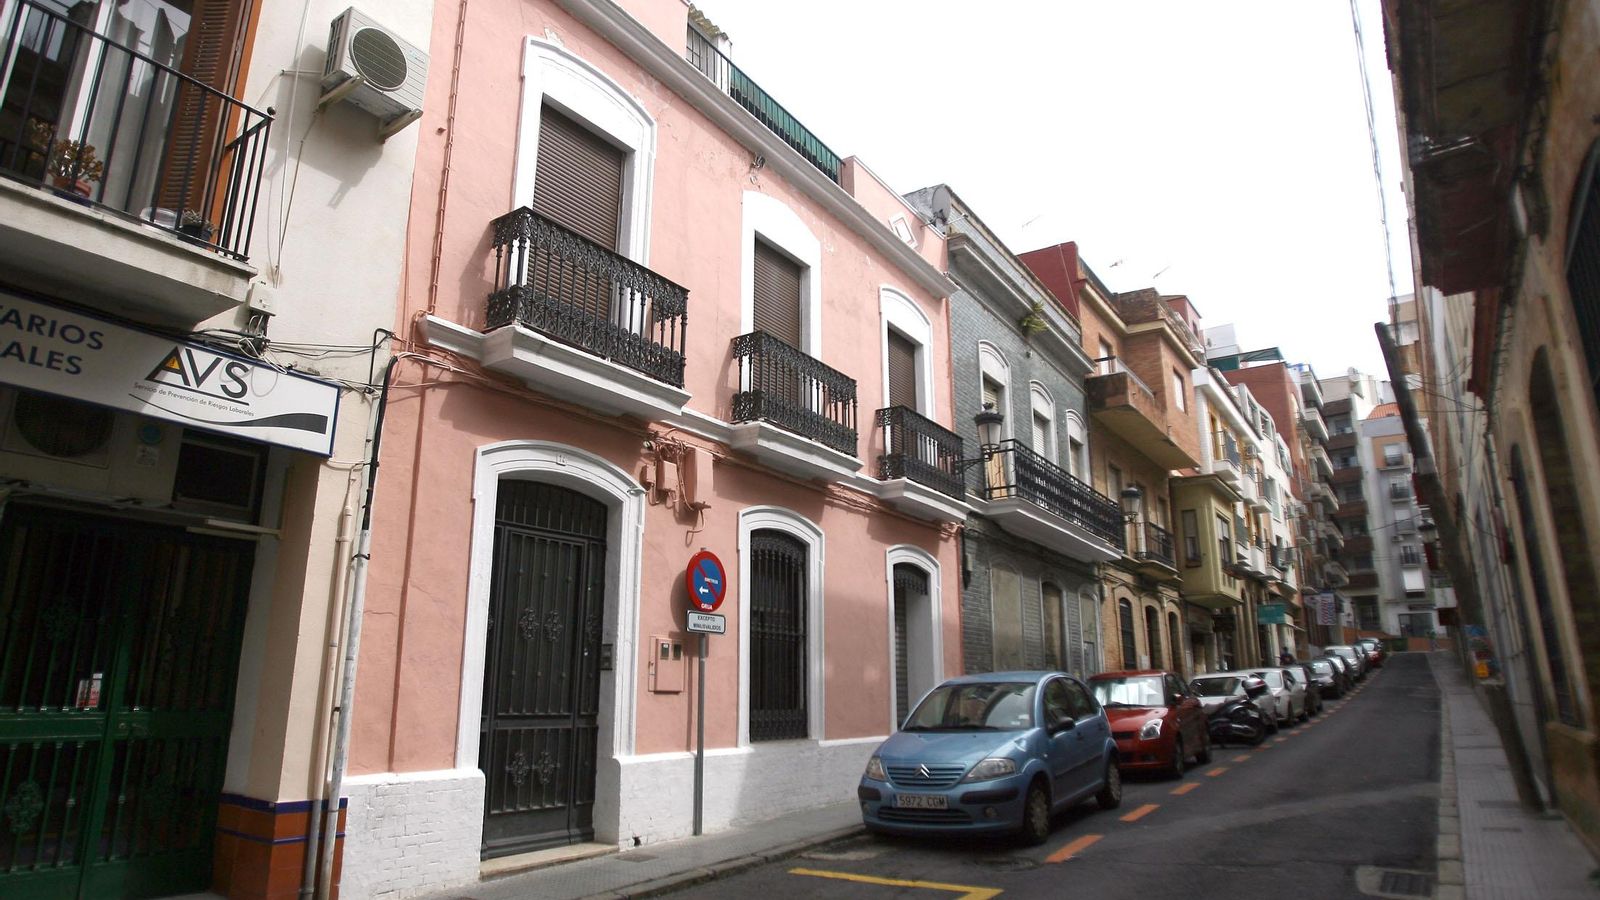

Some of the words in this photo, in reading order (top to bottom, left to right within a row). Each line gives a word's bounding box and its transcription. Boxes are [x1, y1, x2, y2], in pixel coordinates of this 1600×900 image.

[0, 305, 104, 350] ARIOS
[0, 341, 82, 375] ALES
[145, 346, 249, 399] AVS
[134, 382, 158, 393] Servicio
[199, 398, 208, 407] de
[208, 400, 228, 412] Riesgos
[229, 403, 255, 417] Laborales
